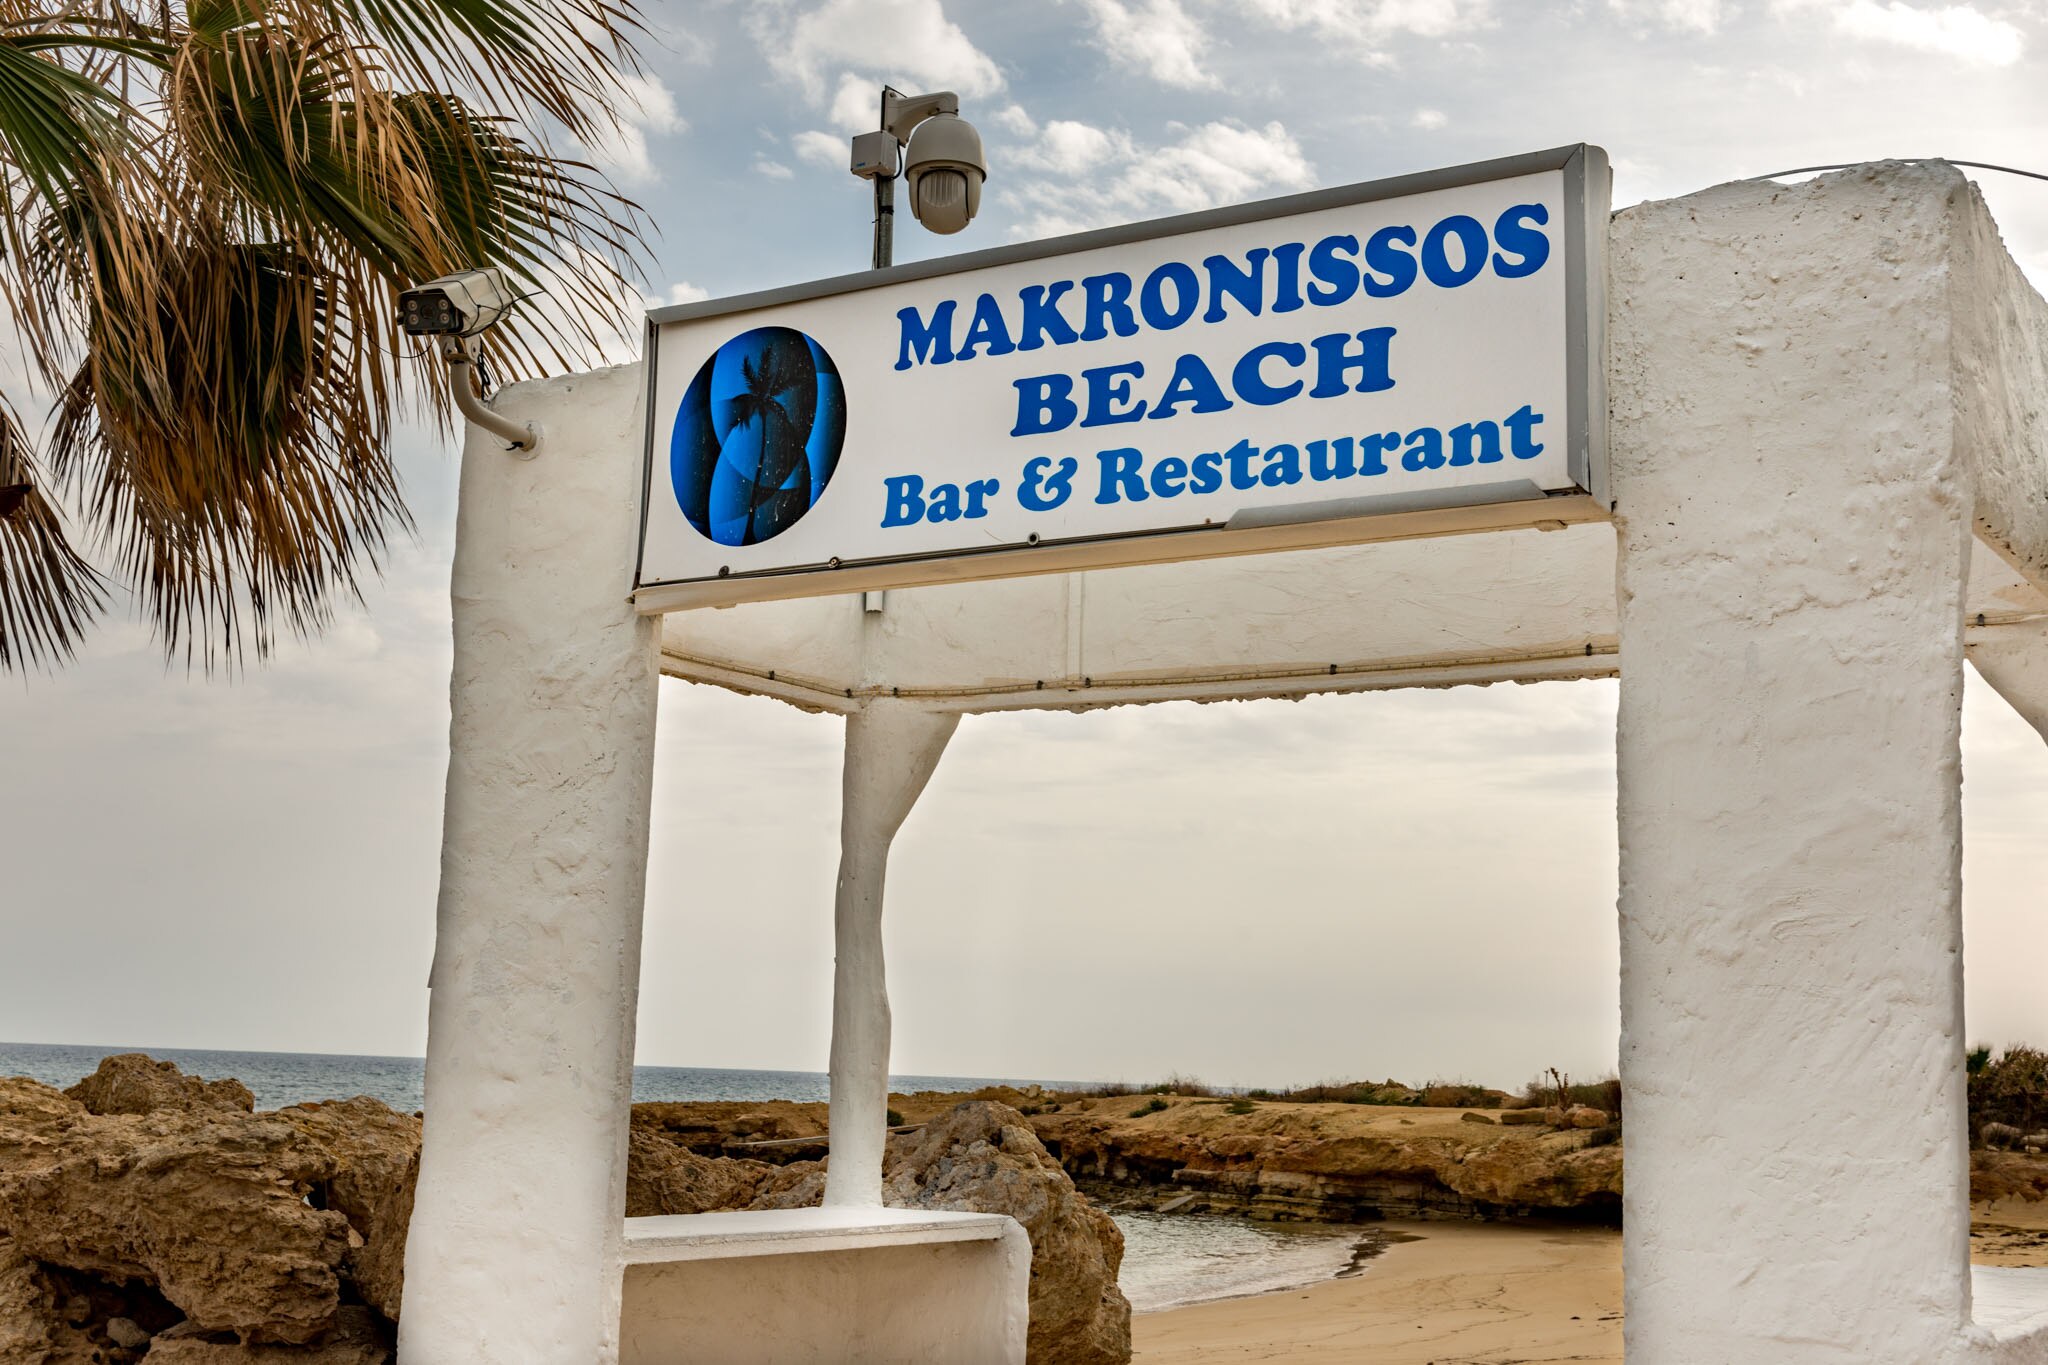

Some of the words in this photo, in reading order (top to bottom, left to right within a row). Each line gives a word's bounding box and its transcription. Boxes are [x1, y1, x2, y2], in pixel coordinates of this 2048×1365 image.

[895, 204, 1550, 371] MAKRONISSOS
[1010, 326, 1397, 437] BEACH
[880, 474, 1001, 529] Bar
[1016, 456, 1079, 512] &
[1094, 404, 1545, 505] Restaurant
